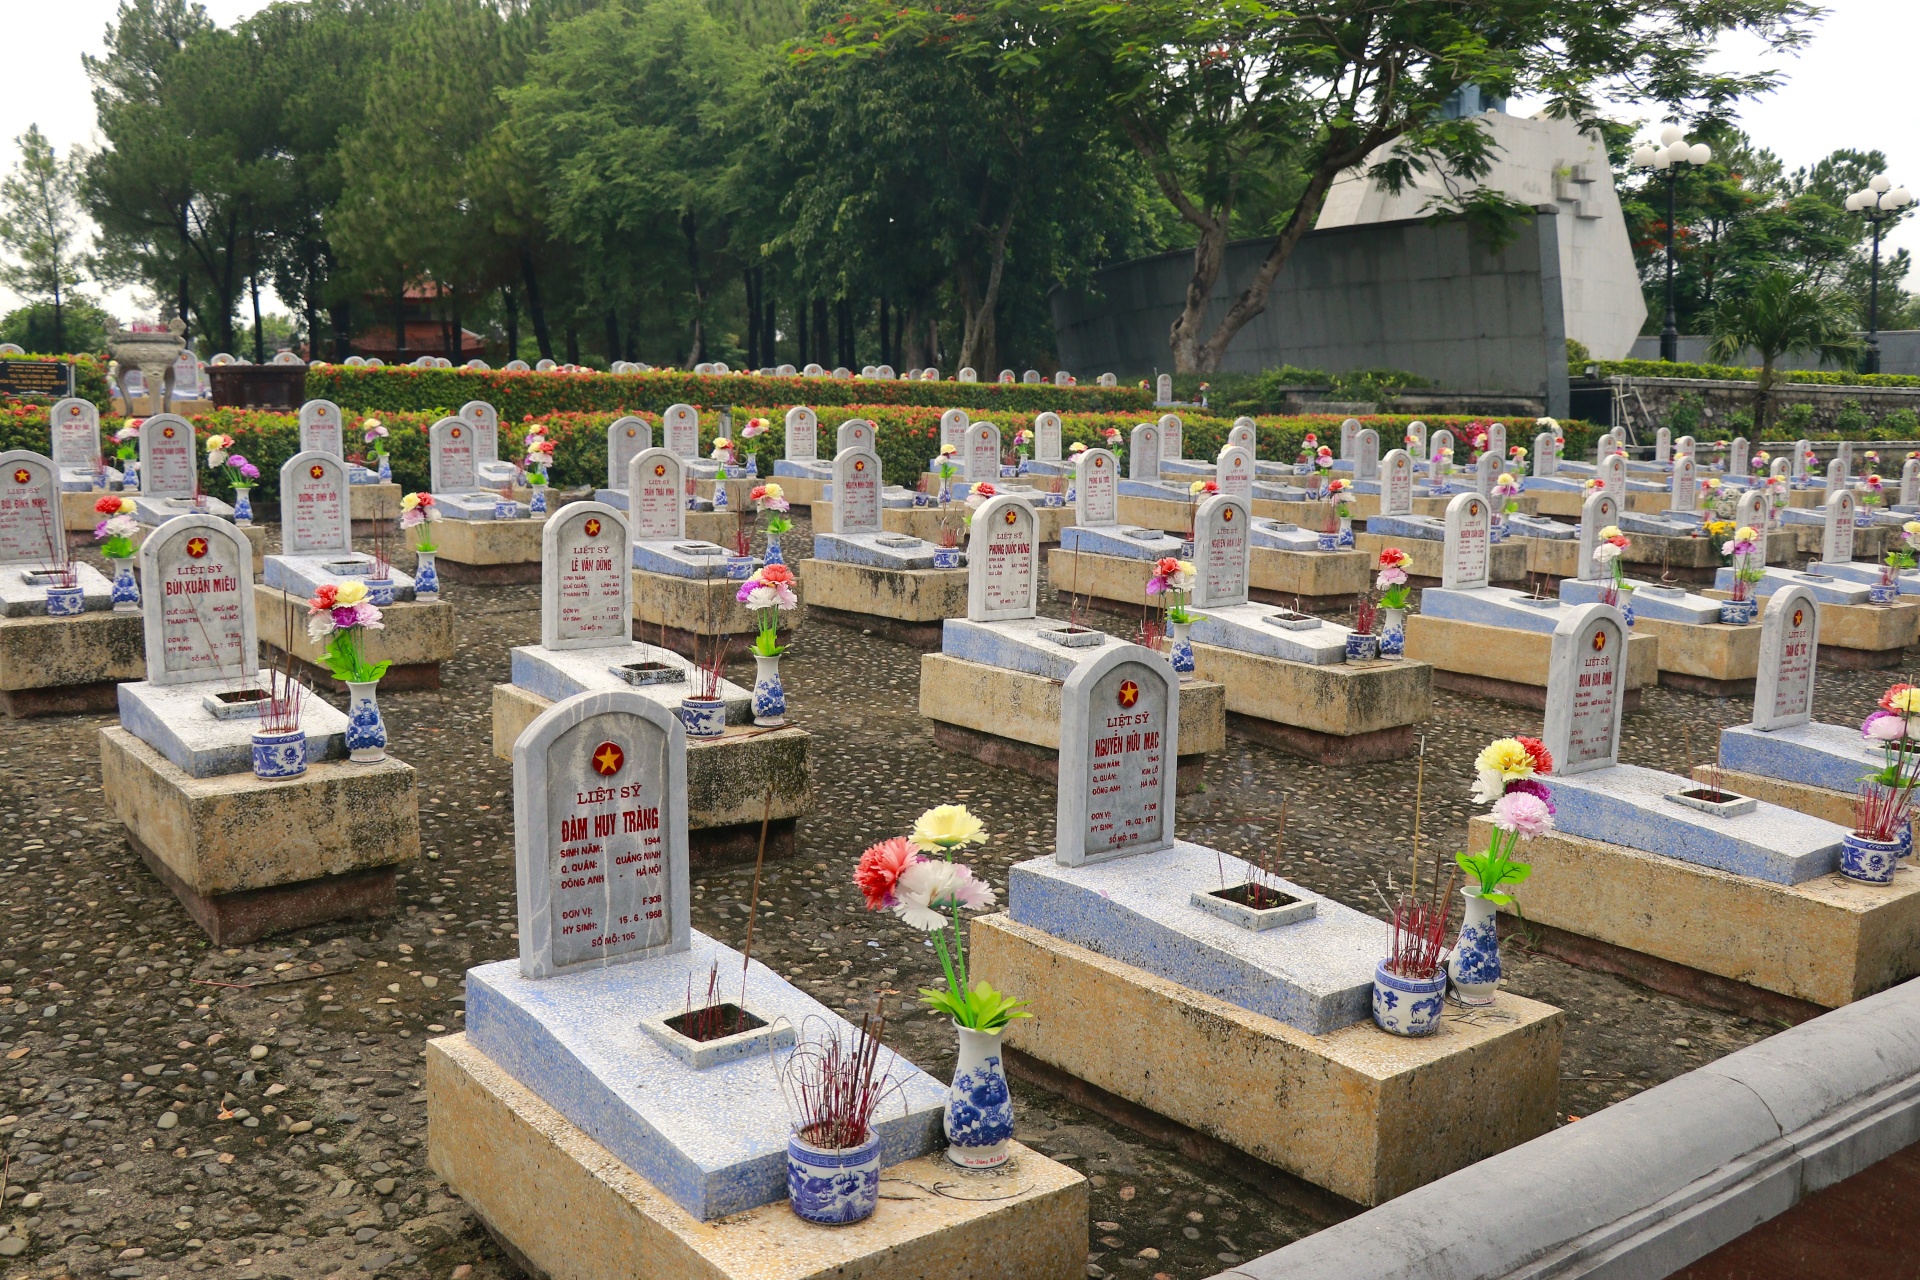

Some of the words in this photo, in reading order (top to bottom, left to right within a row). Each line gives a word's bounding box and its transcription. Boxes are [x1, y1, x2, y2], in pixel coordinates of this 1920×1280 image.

[574, 545, 595, 555] LIỆT
[598, 545, 610, 554] SỸ
[178, 565, 204, 576] LIỆT
[208, 564, 223, 574] SỸ
[166, 579, 182, 595] BÙI
[185, 577, 210, 594] XUÂN
[1585, 656, 1600, 668] LIỆT
[1601, 656, 1609, 666] SỸ
[1107, 714, 1132, 728] LIỆT
[1135, 711, 1150, 724] SỸ
[1095, 730, 1123, 758] NGUYỄN
[1126, 730, 1140, 753] HỮU
[1144, 732, 1159, 753] MẠC
[577, 787, 615, 804] LIỆT
[621, 782, 642, 798] SỸ
[562, 815, 588, 842] ĐÀM
[595, 813, 616, 838] HUY
[560, 848, 579, 858] SINH
[581, 844, 603, 855] NĂM:
[644, 836, 660, 845] 1944
[572, 860, 597, 872] QUÁN:
[561, 878, 585, 889] ĐÔNG
[588, 875, 604, 884] ANH
[636, 865, 646, 876] HÀ
[648, 864, 661, 876] NỘI
[562, 910, 580, 919] ĐƠN
[582, 907, 592, 917] VỊ:
[563, 926, 574, 934] HY
[576, 922, 597, 932] SINH:
[592, 934, 604, 947] SỐ
[605, 933, 620, 945] MỘ:
